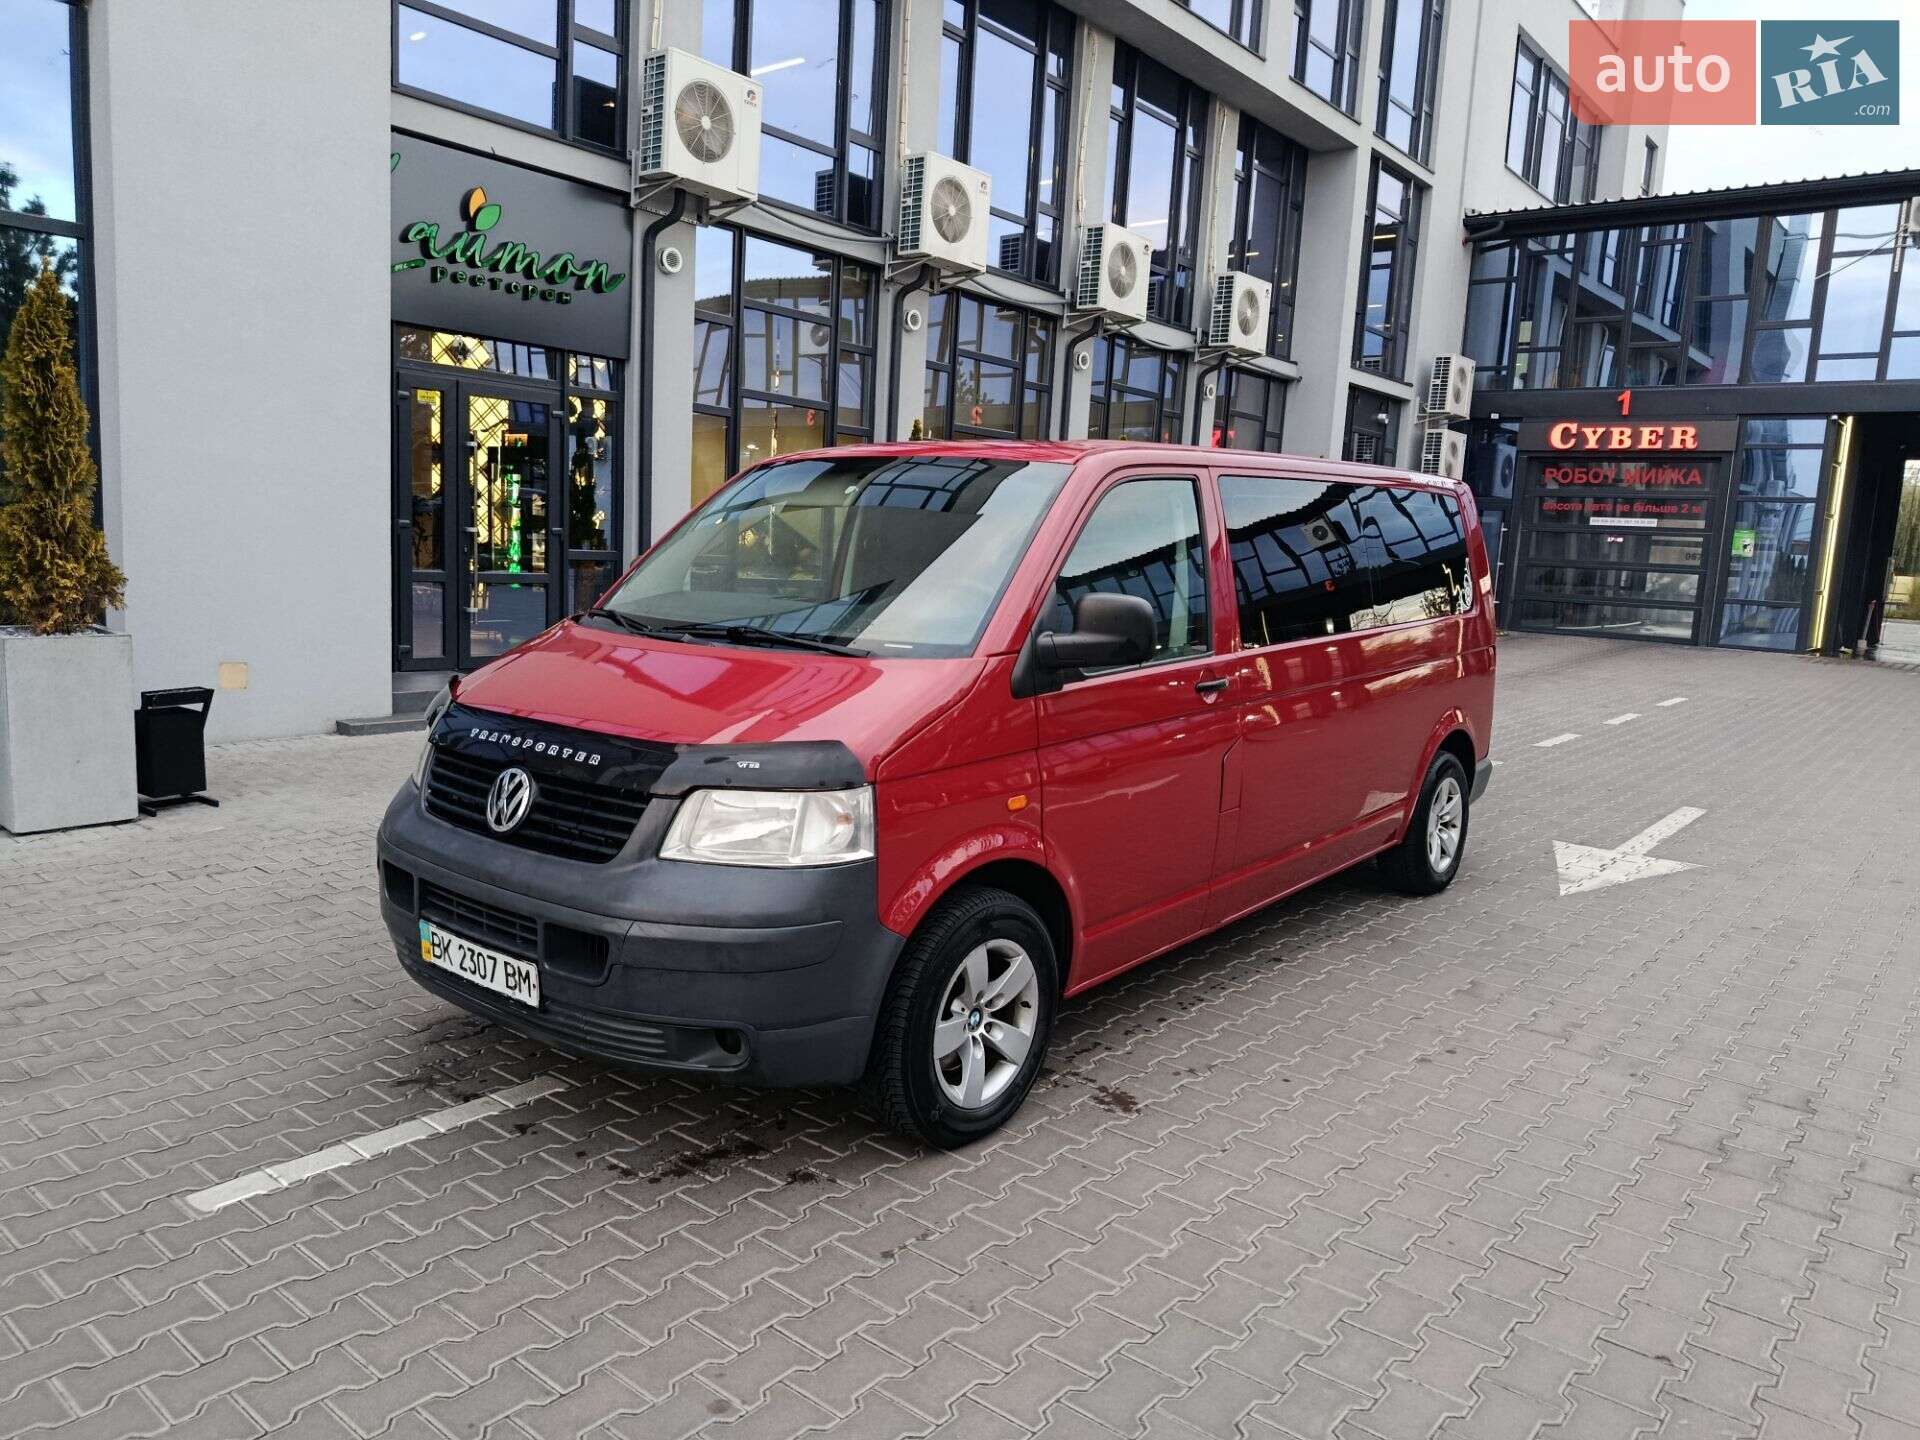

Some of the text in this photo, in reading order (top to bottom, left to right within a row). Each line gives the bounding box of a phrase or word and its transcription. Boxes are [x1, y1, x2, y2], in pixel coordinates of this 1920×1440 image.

[1617, 389, 1632, 416] 1
[1549, 421, 1699, 450] CYBER
[470, 728, 601, 765] TRANSPORTER
[459, 944, 497, 983] 2307
[504, 961, 531, 998] BM
